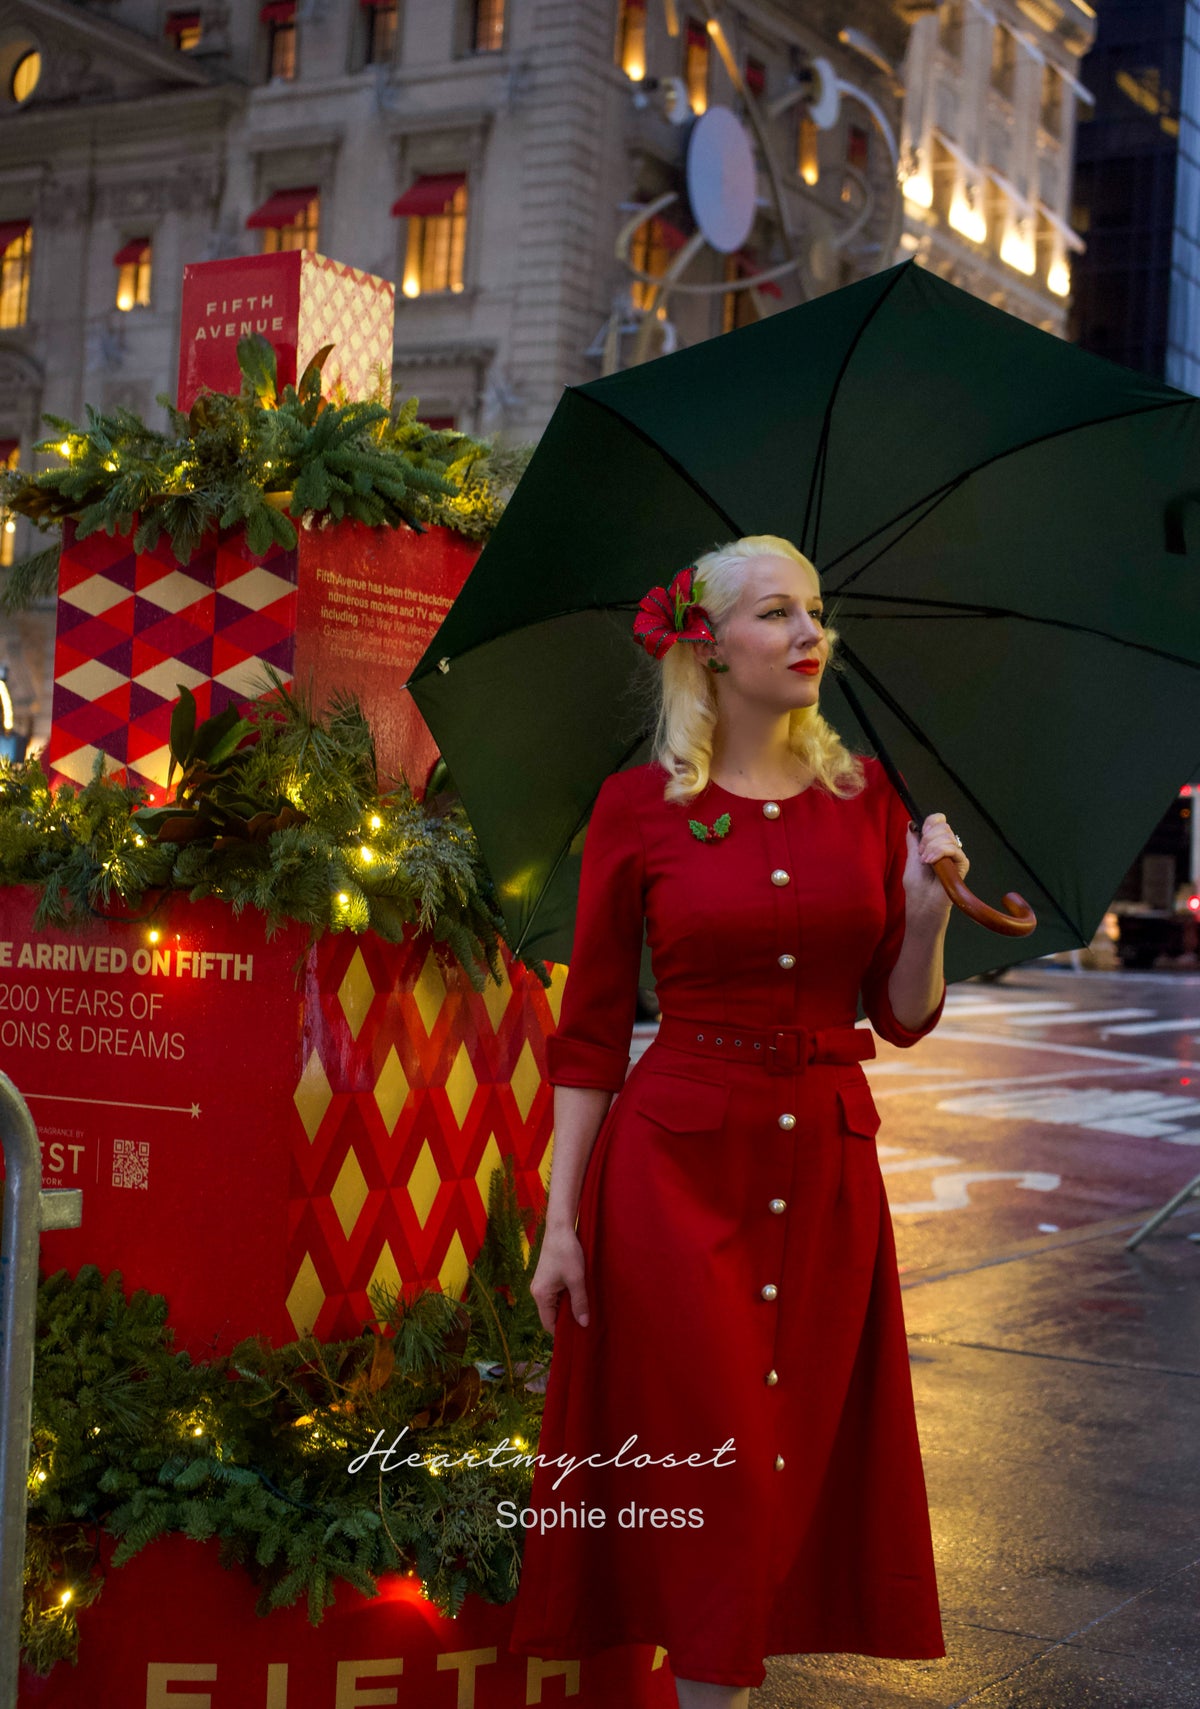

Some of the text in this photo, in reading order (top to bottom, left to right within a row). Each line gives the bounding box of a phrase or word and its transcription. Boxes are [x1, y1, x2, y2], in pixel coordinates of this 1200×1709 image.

[206, 294, 273, 317] FIFTH
[195, 317, 283, 341] AVENUE
[316, 568, 335, 584] Fifth
[337, 574, 367, 591] Avenue
[368, 580, 382, 595] has
[383, 583, 403, 598] been
[405, 587, 418, 602] the
[321, 604, 359, 627] including
[328, 591, 369, 609] numerous
[370, 600, 398, 615] movies
[400, 605, 415, 618] and
[416, 605, 428, 620] TV
[17, 943, 127, 974] ARRIVED
[132, 949, 170, 976] ON
[175, 950, 253, 981] FIFTH
[0, 983, 164, 1021] 200 YEARS OF
[56, 1024, 73, 1051] &
[80, 1026, 185, 1060] DREAMS
[38, 1127, 73, 1137] RAGRANCE
[146, 1646, 581, 1709] FIFTH
